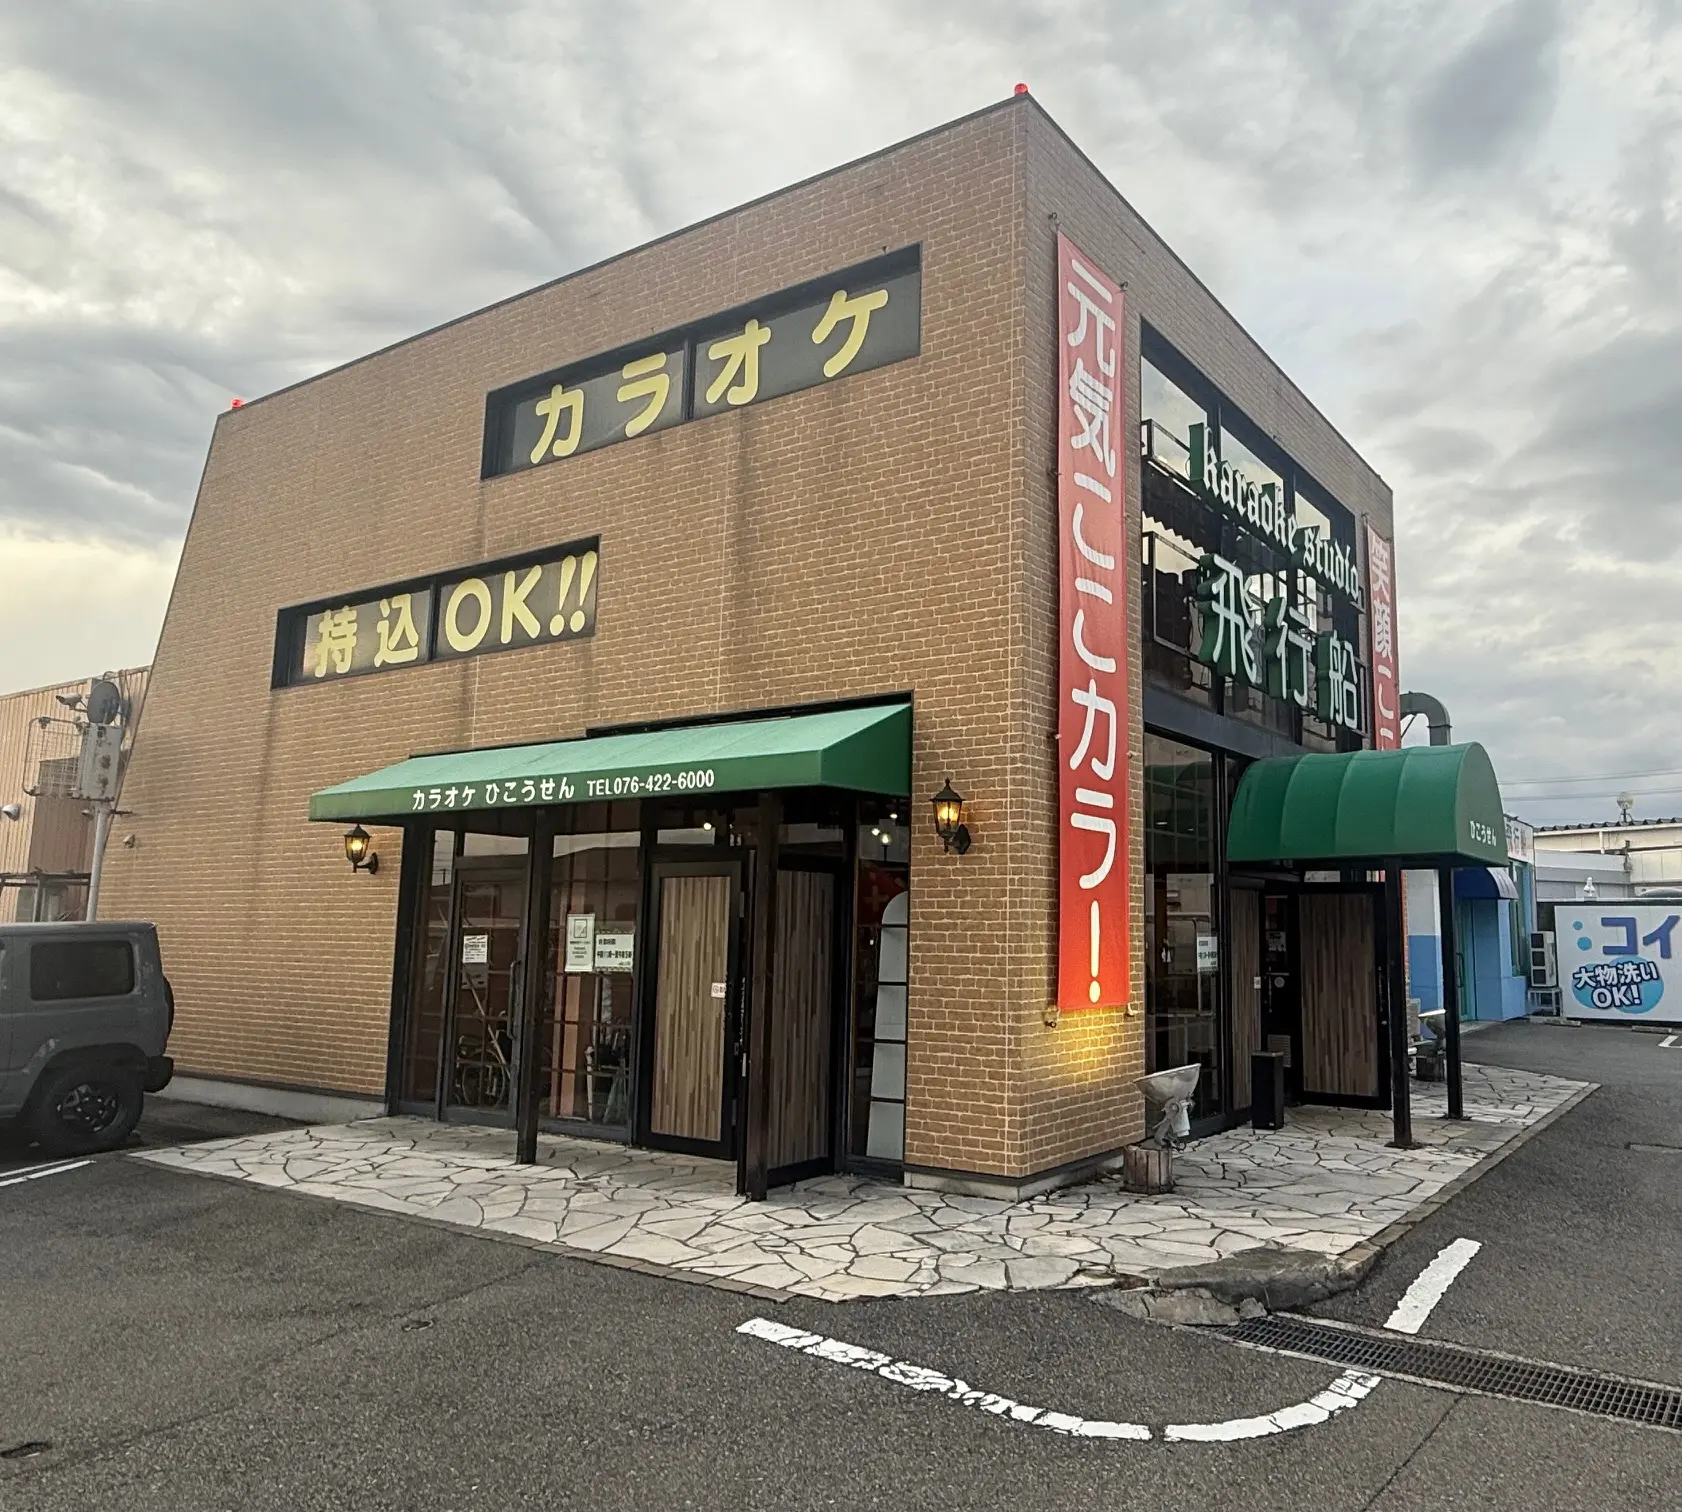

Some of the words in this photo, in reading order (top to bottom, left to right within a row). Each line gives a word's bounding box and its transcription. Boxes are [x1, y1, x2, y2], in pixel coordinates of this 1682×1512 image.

[530, 288, 889, 464] カラオケ
[1203, 426, 1297, 554] karaoke
[1303, 524, 1360, 601] studio
[1211, 553, 1358, 729] 飛行船
[412, 785, 476, 811] カラオケ
[485, 777, 575, 804] ひこうせん
[1469, 820, 1497, 847] ひこうせん
[1600, 915, 1681, 960] コイ
[1573, 961, 1659, 989] 大物洗い
[1592, 983, 1642, 1009] OK!
